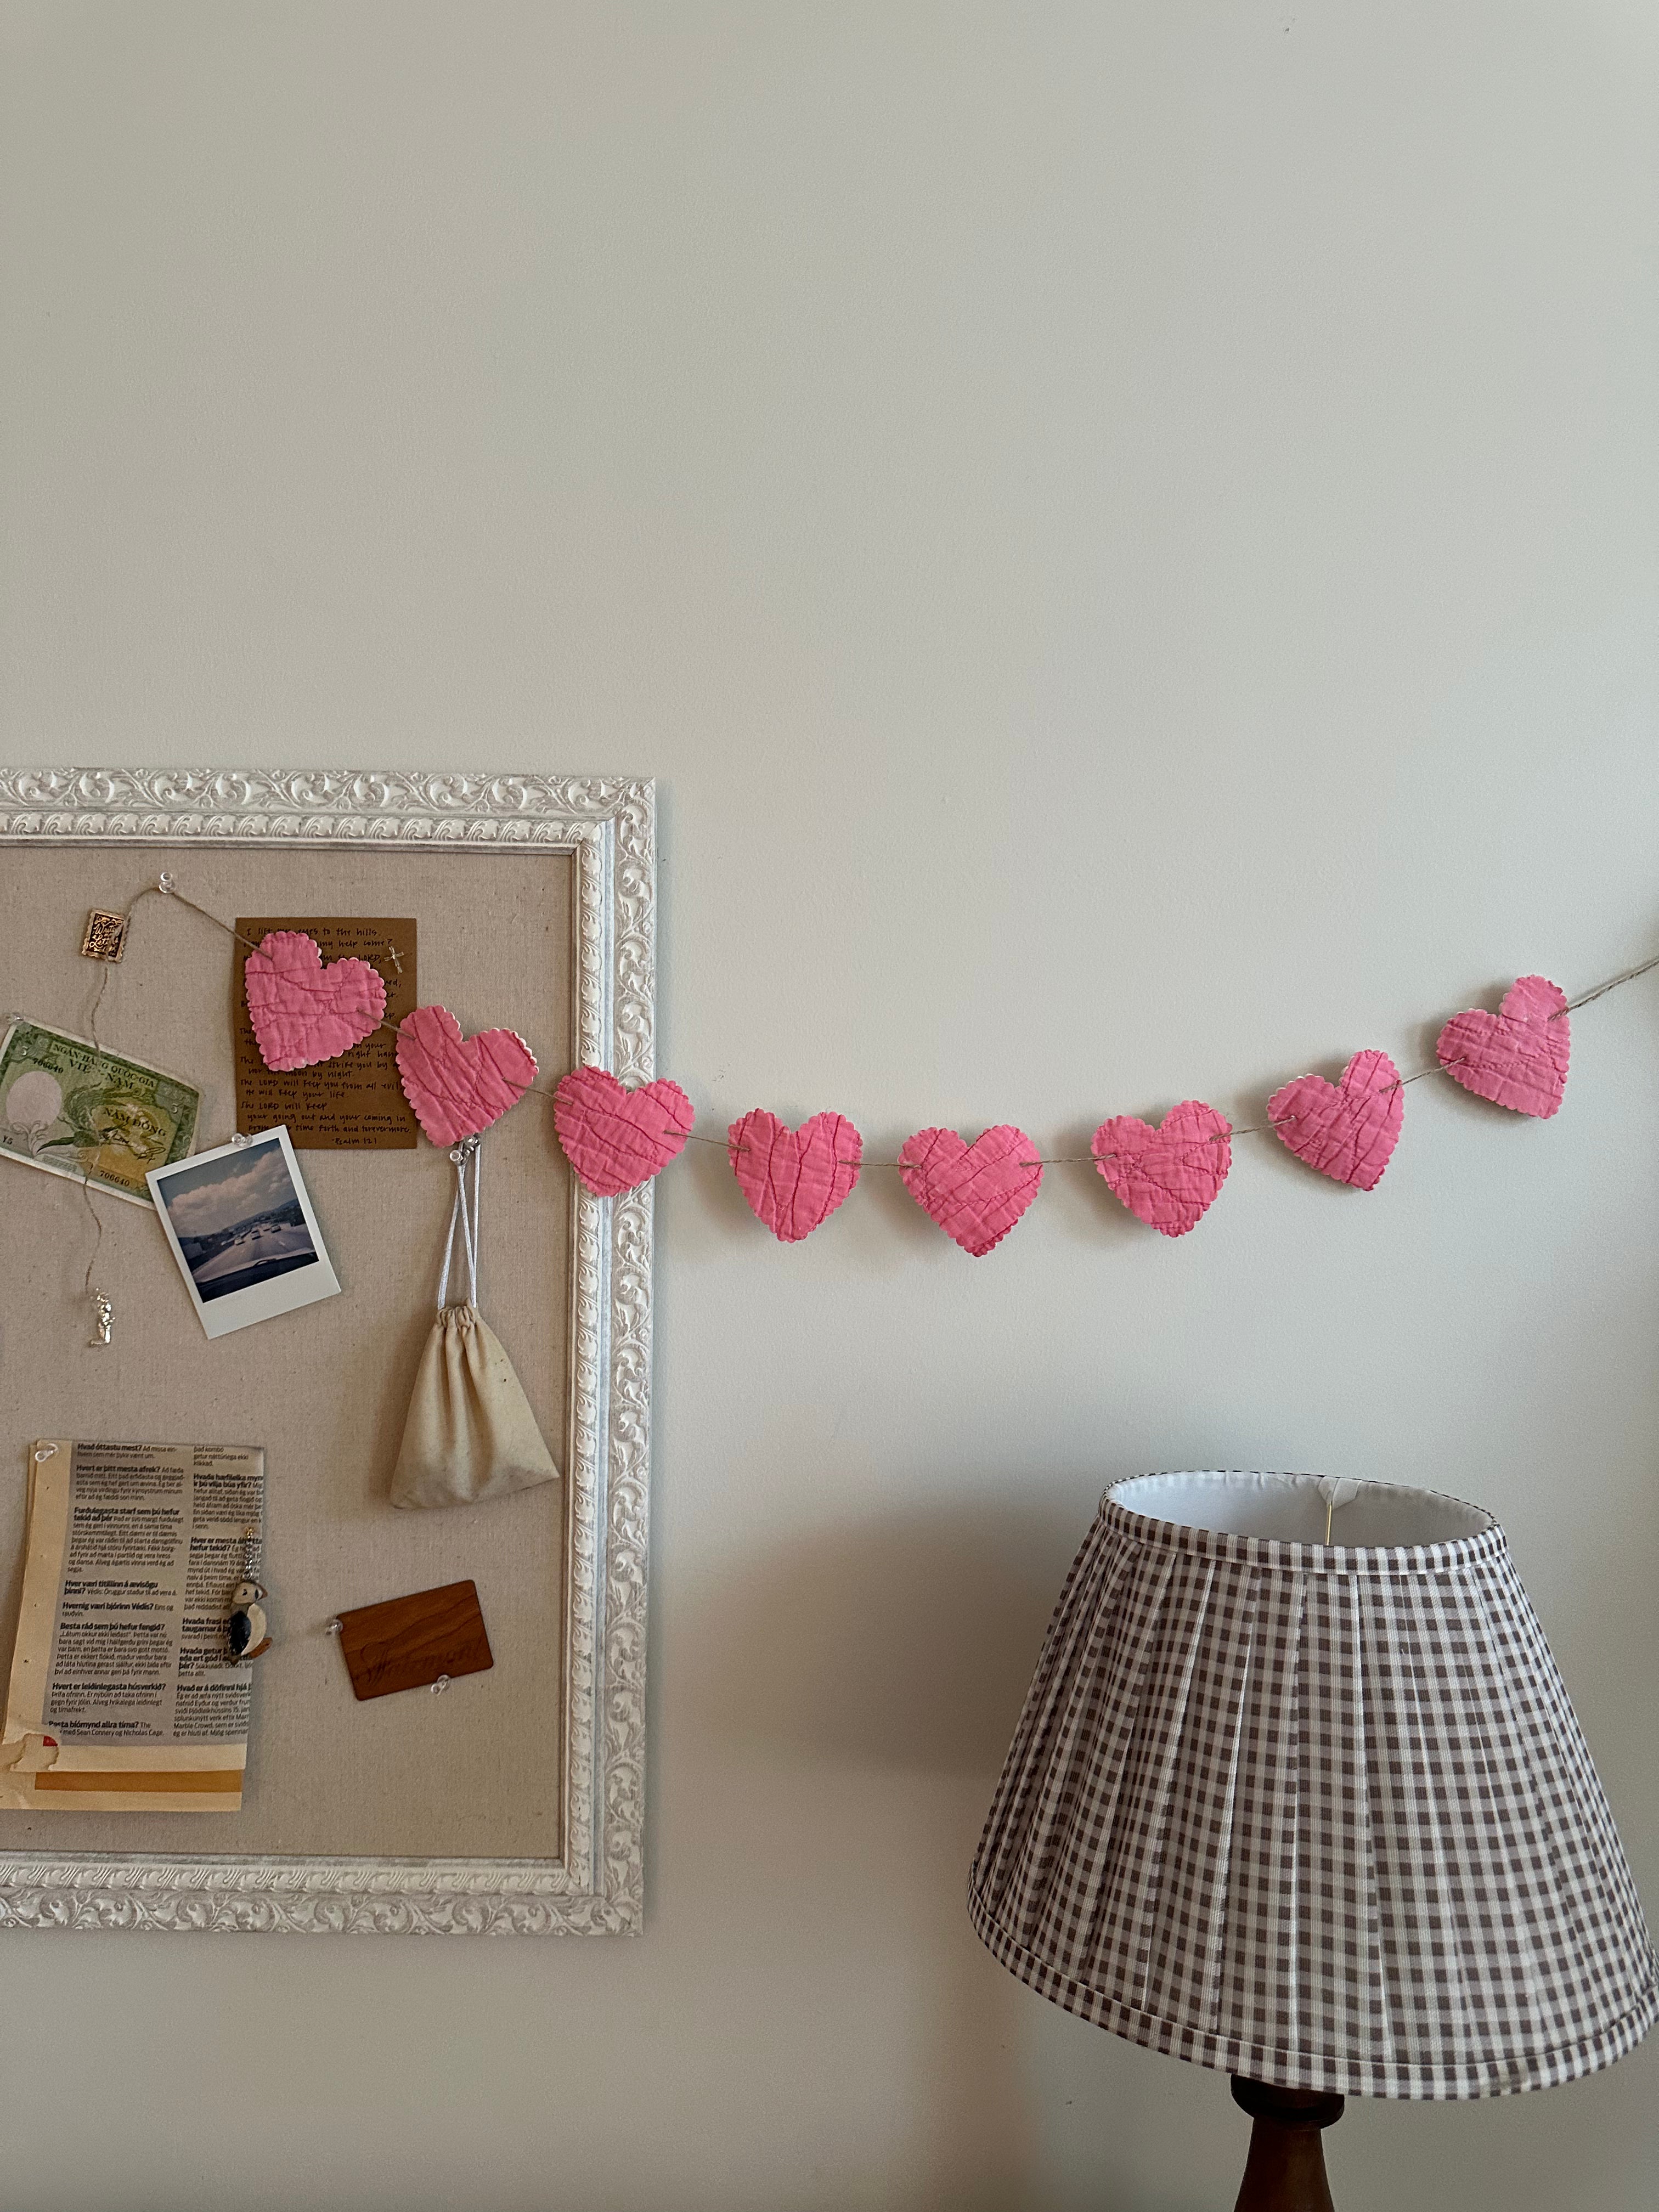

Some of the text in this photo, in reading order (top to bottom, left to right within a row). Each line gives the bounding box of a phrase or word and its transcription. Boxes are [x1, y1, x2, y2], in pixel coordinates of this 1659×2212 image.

[336, 928, 351, 936] the
[365, 1043, 387, 1052] your
[348, 1051, 371, 1059] right
[240, 1056, 253, 1064] The
[357, 1062, 371, 1070] you
[377, 1061, 388, 1069] by
[312, 1070, 323, 1079] by
[303, 1080, 321, 1089] keep
[324, 1081, 338, 1090] you
[341, 1082, 362, 1090] from
[366, 1082, 376, 1090] all
[279, 1089, 297, 1098] keep
[302, 1091, 324, 1101] your
[306, 1102, 328, 1111] keep
[247, 1114, 267, 1122] your
[273, 1114, 296, 1123] going
[340, 1114, 360, 1124] your
[364, 1115, 392, 1125] coming
[362, 1125, 411, 1134] forevermore.
[69, 1720, 100, 1729] bíómynd
